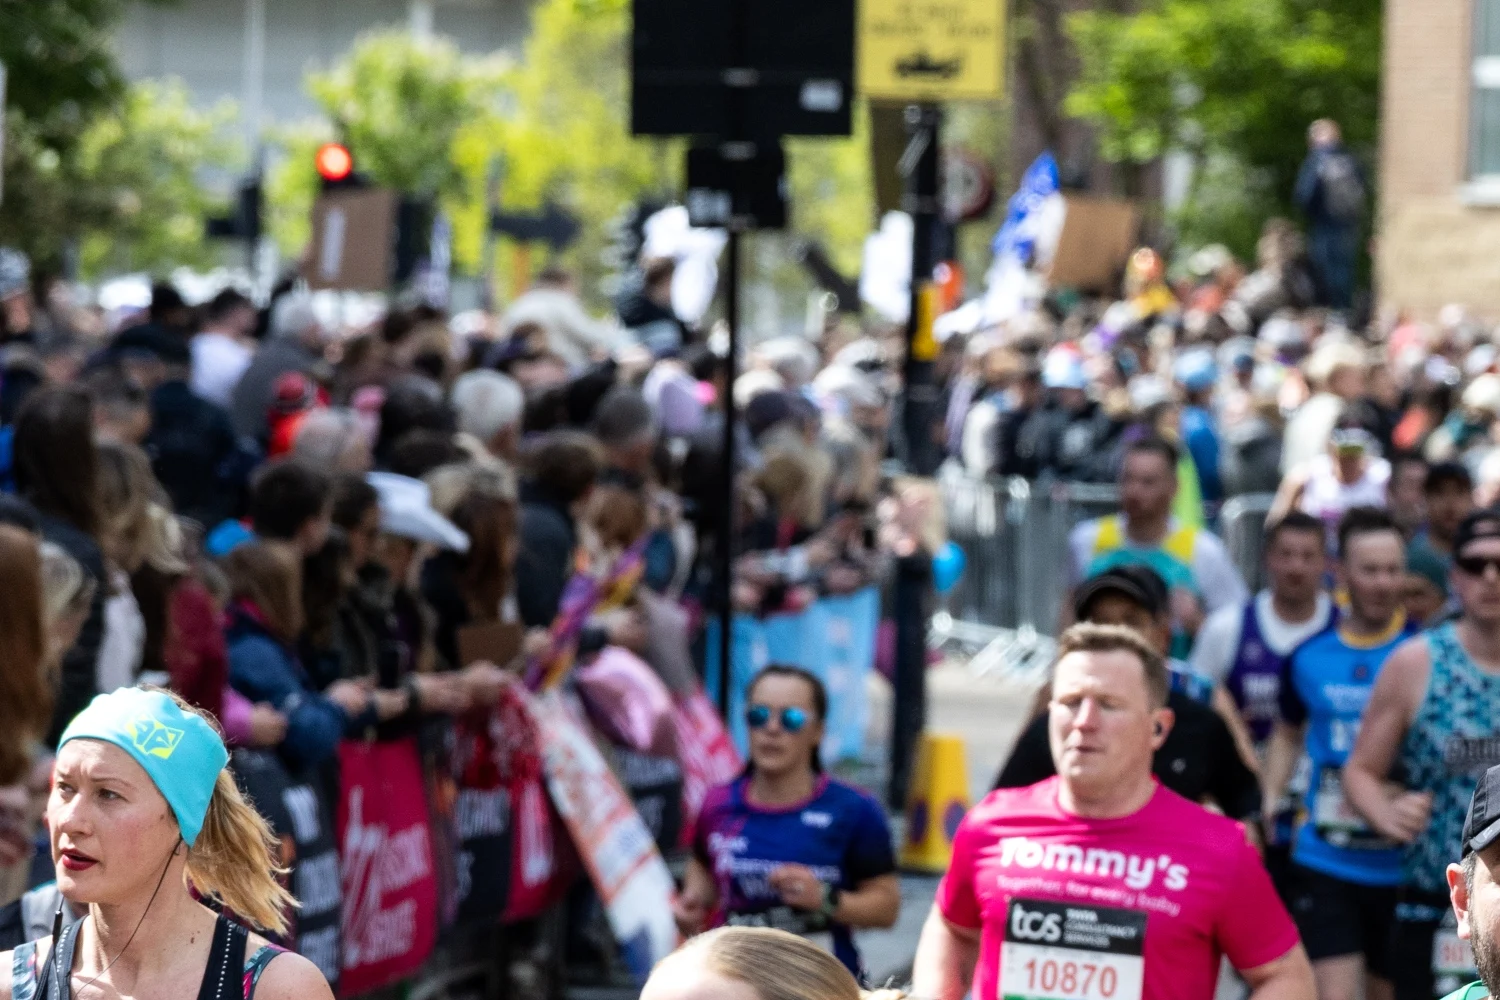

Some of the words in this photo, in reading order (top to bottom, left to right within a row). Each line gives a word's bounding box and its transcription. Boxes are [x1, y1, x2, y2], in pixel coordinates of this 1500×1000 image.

[1000, 837, 1189, 890] Tommy's
[1011, 903, 1061, 942] tcs
[1026, 957, 1118, 998] 10870
